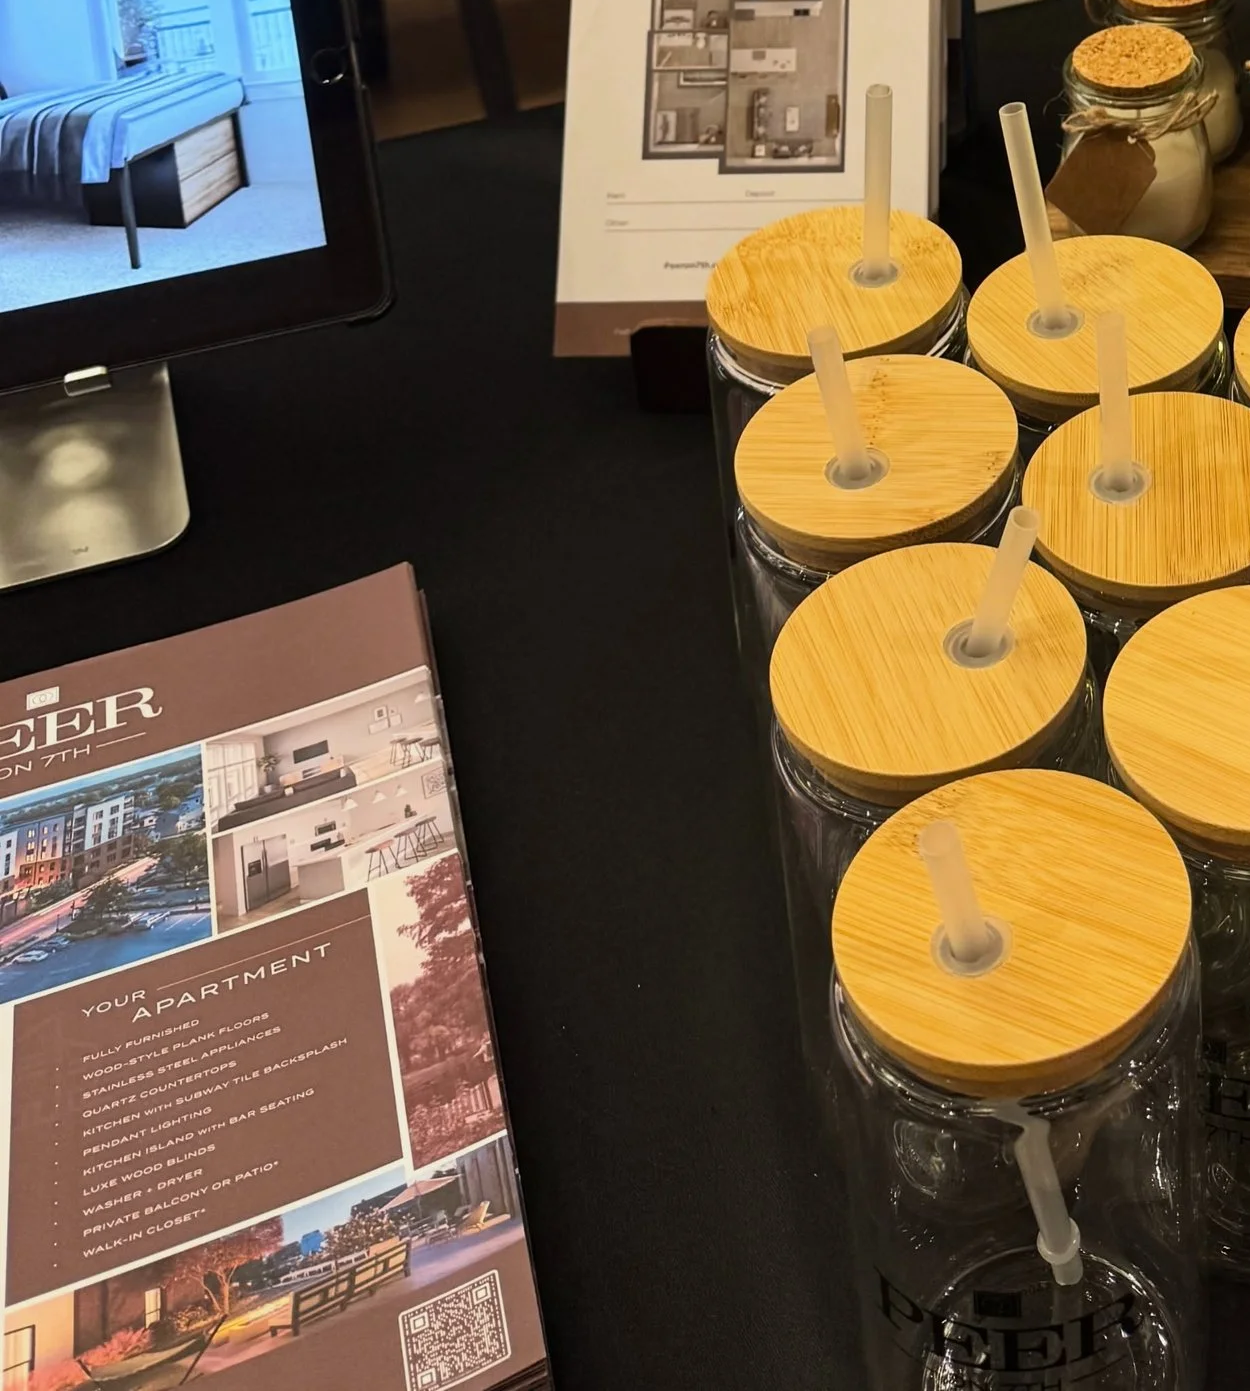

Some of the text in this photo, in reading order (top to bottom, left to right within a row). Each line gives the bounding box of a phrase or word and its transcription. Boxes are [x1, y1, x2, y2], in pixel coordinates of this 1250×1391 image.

[40, 744, 91, 767] 7TH
[82, 989, 145, 1017] YOUR
[132, 943, 331, 1022] APARTMENT
[82, 1026, 281, 1099] STAINLESS STEEL APPLIANCES
[83, 1020, 200, 1062] FULLY FURNISHED
[83, 1013, 269, 1080] WOOD-STYLE PLANK FLOORS
[82, 1061, 237, 1118] QUARTZ COUNTERTOPS
[83, 1038, 347, 1137] KITCHEN WITH SUBWAY TILE BACKSPLASH
[83, 1106, 212, 1156] PENDANT LIGHTING
[83, 1088, 315, 1176] KITCHEN ISLAND WITH BAR SEATING
[83, 1144, 216, 1196] LUXE WOOD BLINDS
[83, 1190, 142, 1216] WASHER
[157, 1168, 203, 1191] DRYER
[83, 1211, 140, 1237] PRIVATE
[144, 1187, 208, 1215] BALCONY
[212, 1178, 231, 1191] OR
[83, 1231, 142, 1258] WALK-IN
[873, 1264, 1145, 1371] PEER
